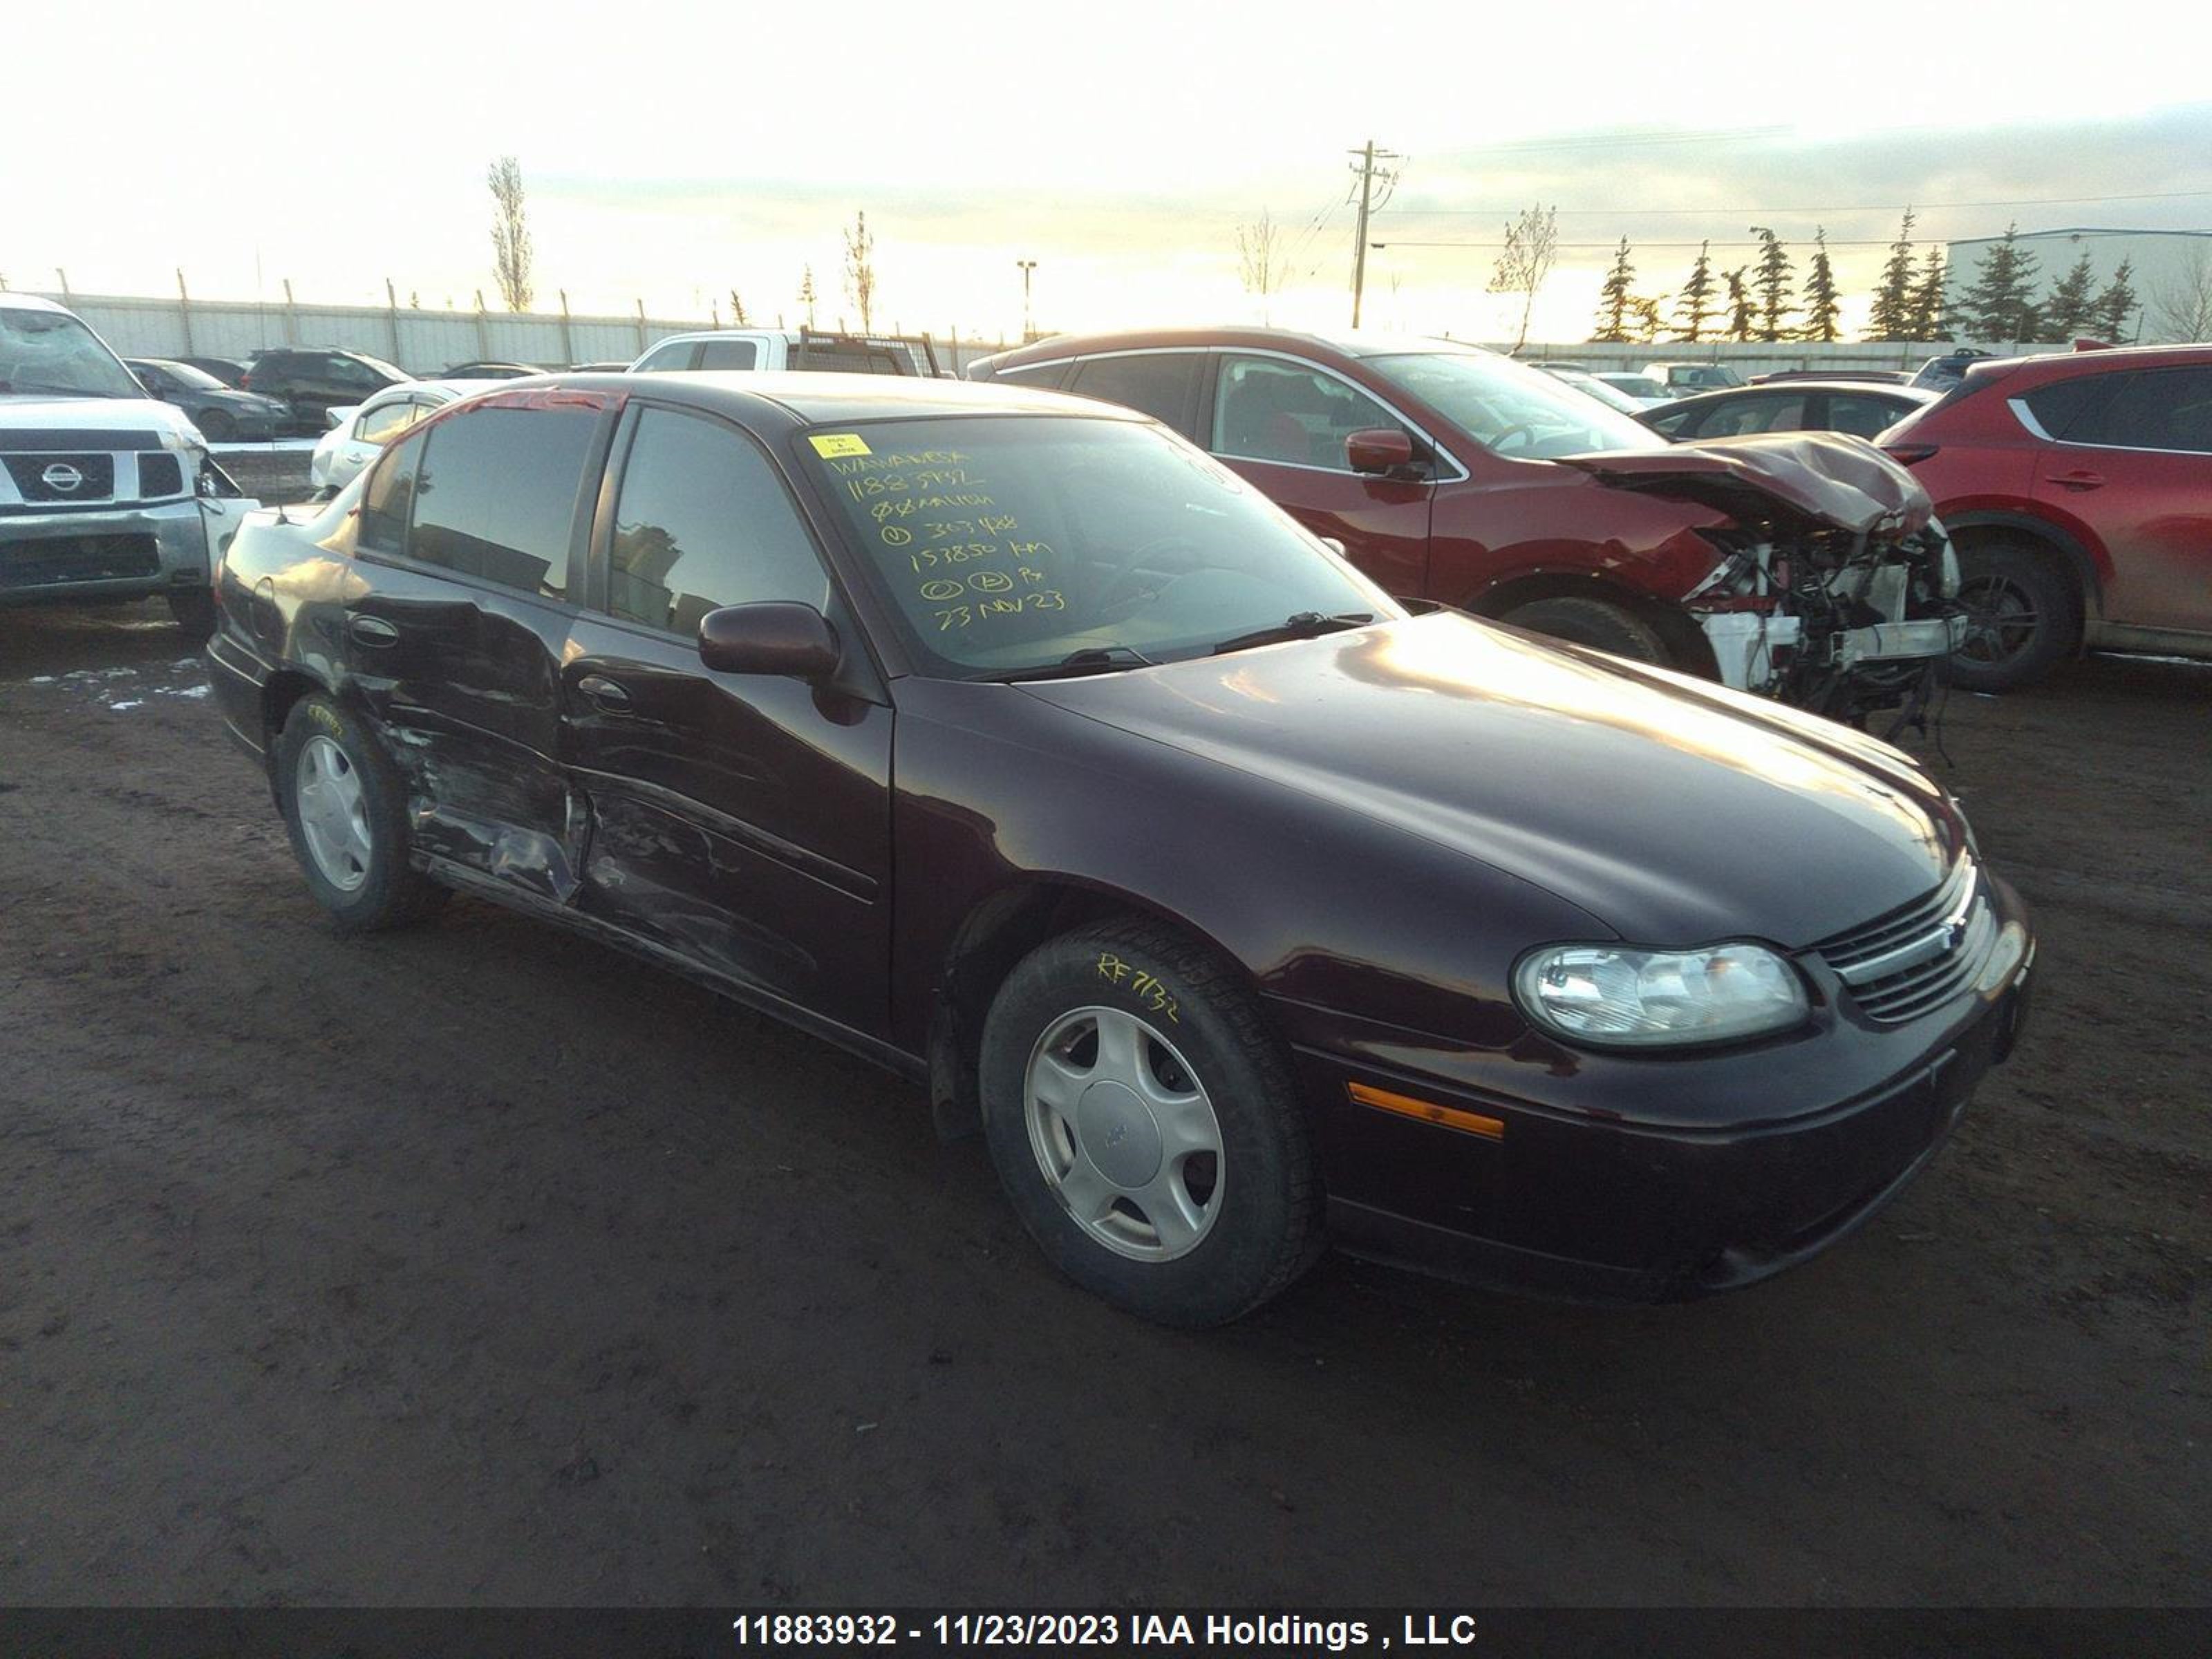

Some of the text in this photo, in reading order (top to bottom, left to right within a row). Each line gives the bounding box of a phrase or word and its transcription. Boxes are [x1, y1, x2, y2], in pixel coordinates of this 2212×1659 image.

[935, 590, 1065, 631] 23 NOV 23
